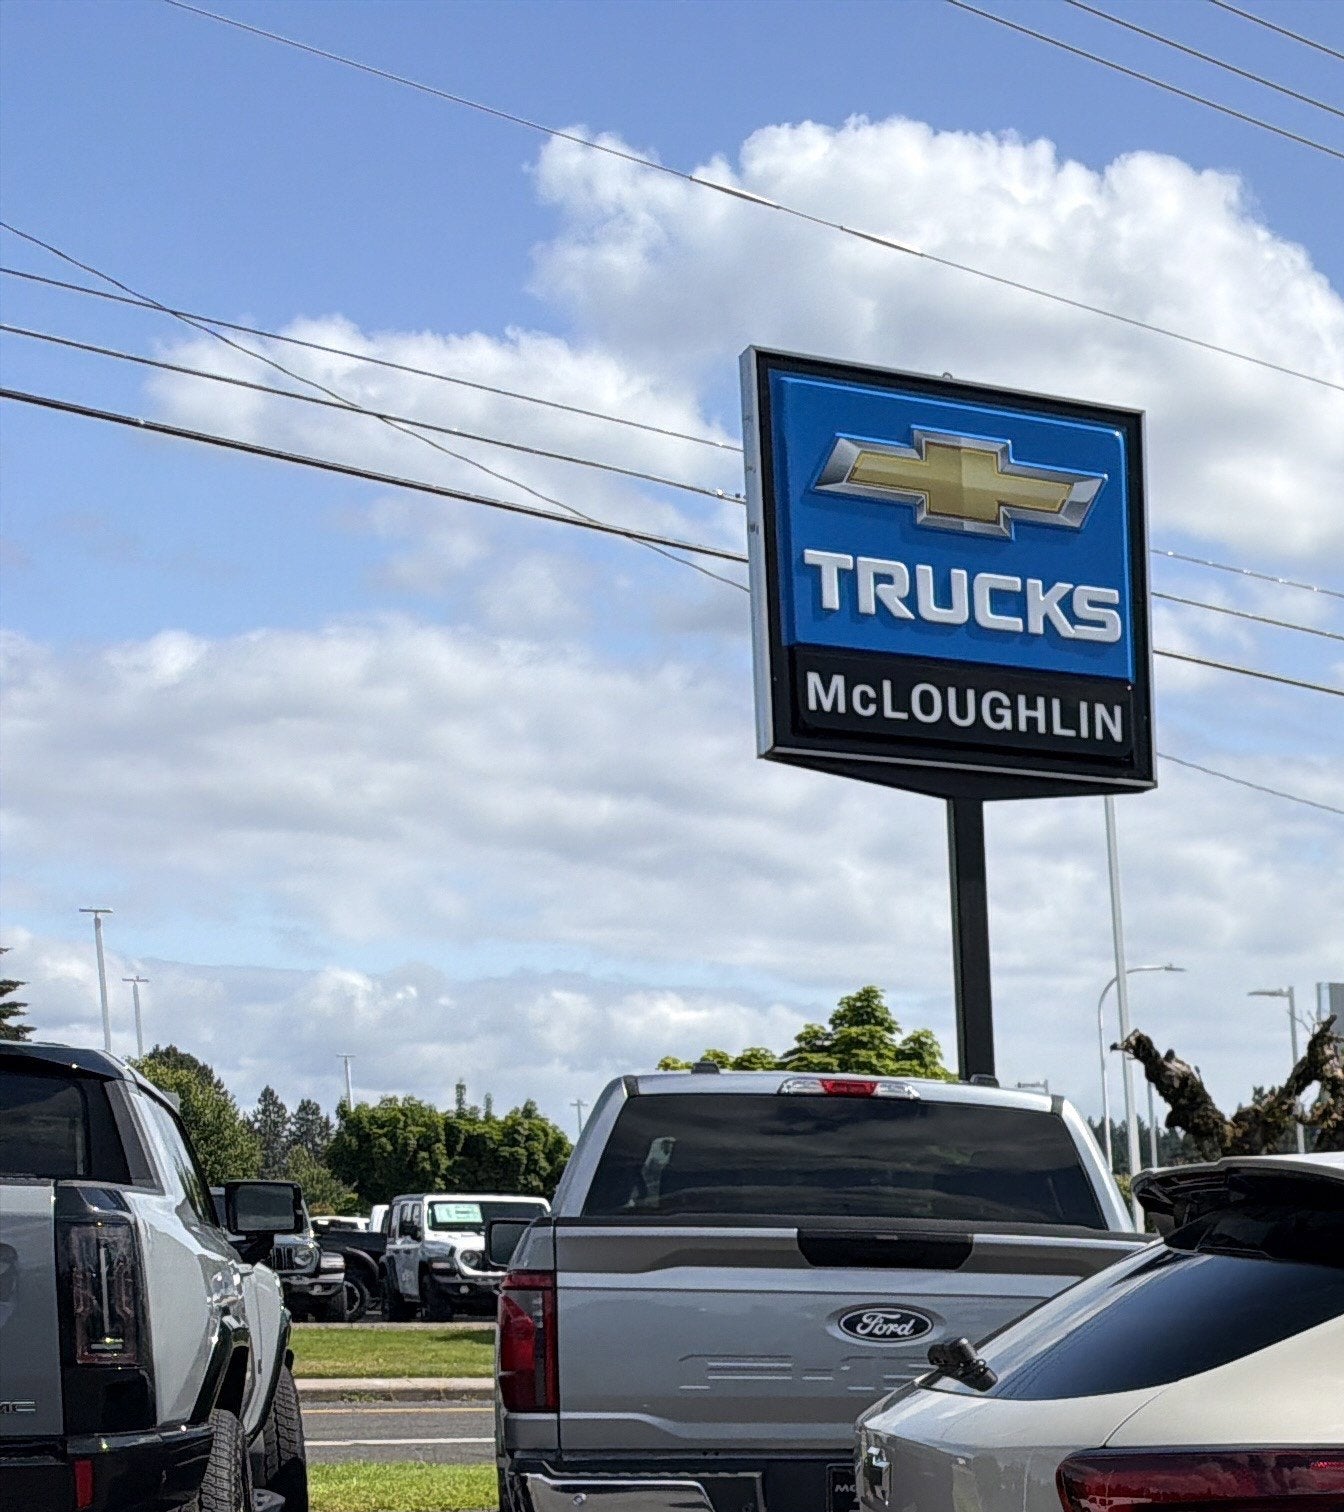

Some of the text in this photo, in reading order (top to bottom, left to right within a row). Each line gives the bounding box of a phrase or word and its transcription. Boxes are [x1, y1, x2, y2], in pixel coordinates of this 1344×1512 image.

[803, 548, 1122, 643] TRUCKS
[806, 671, 1124, 743] McLOUGHLIN
[856, 1312, 916, 1336] Ford
